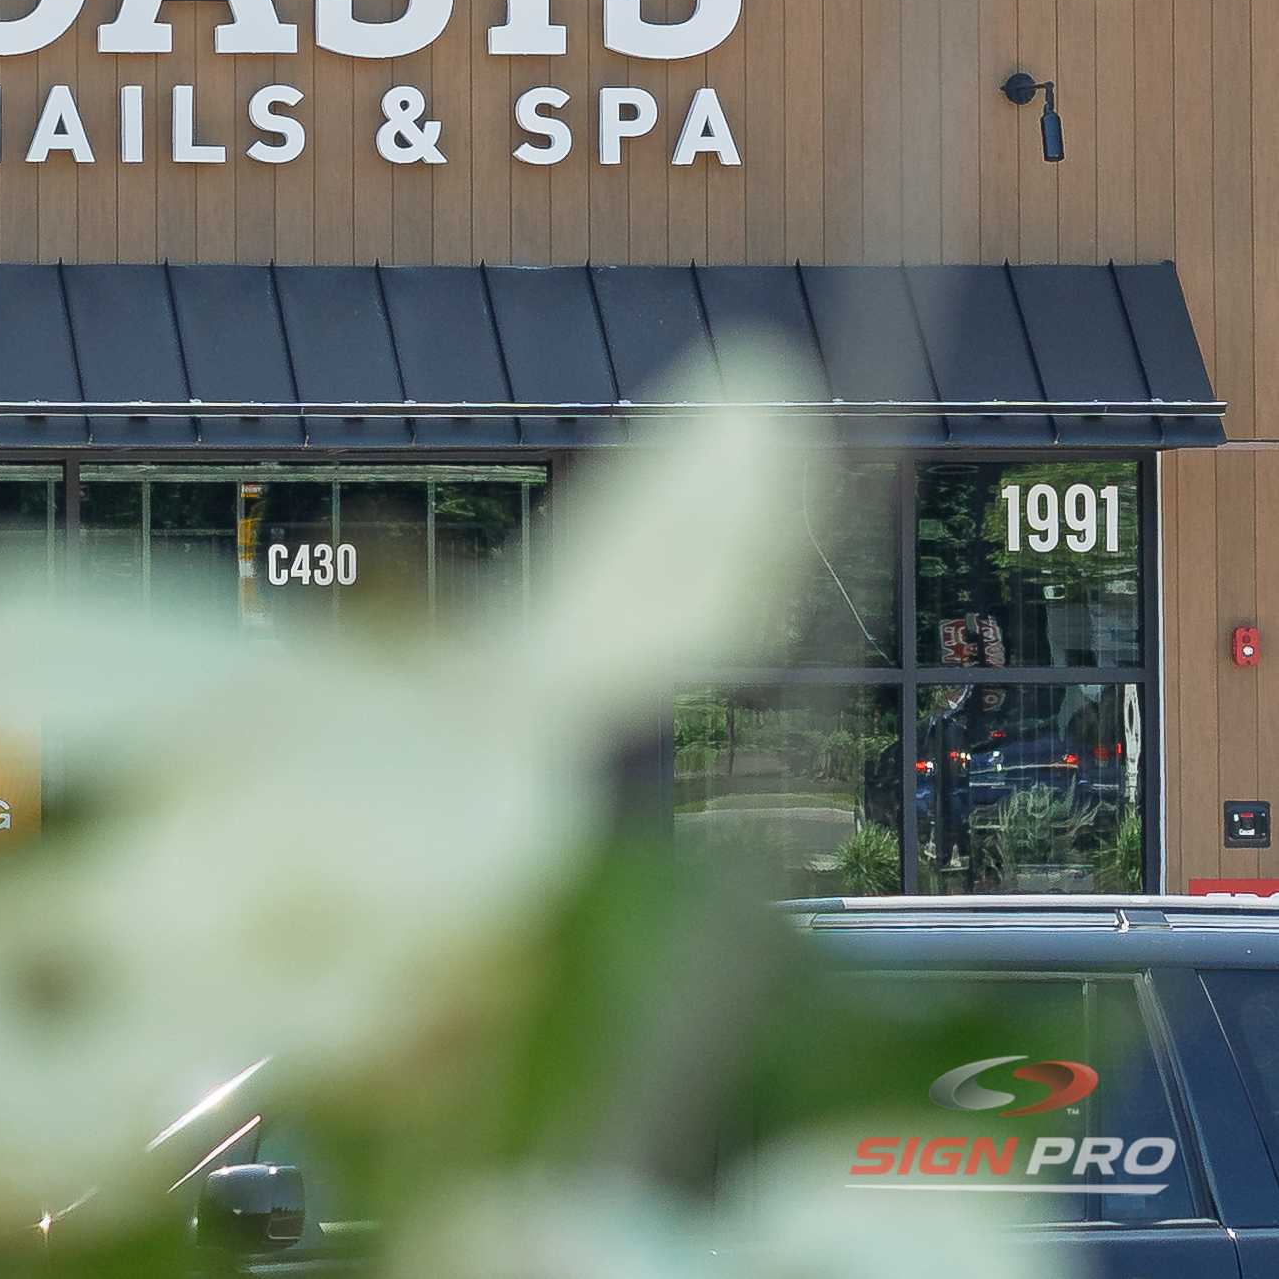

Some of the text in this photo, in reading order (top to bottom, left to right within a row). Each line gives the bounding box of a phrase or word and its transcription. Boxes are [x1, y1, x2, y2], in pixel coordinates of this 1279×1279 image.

[375, 84, 449, 165] &
[512, 85, 742, 167] SPA
[1001, 483, 1119, 553] 1991
[268, 543, 357, 586] C430
